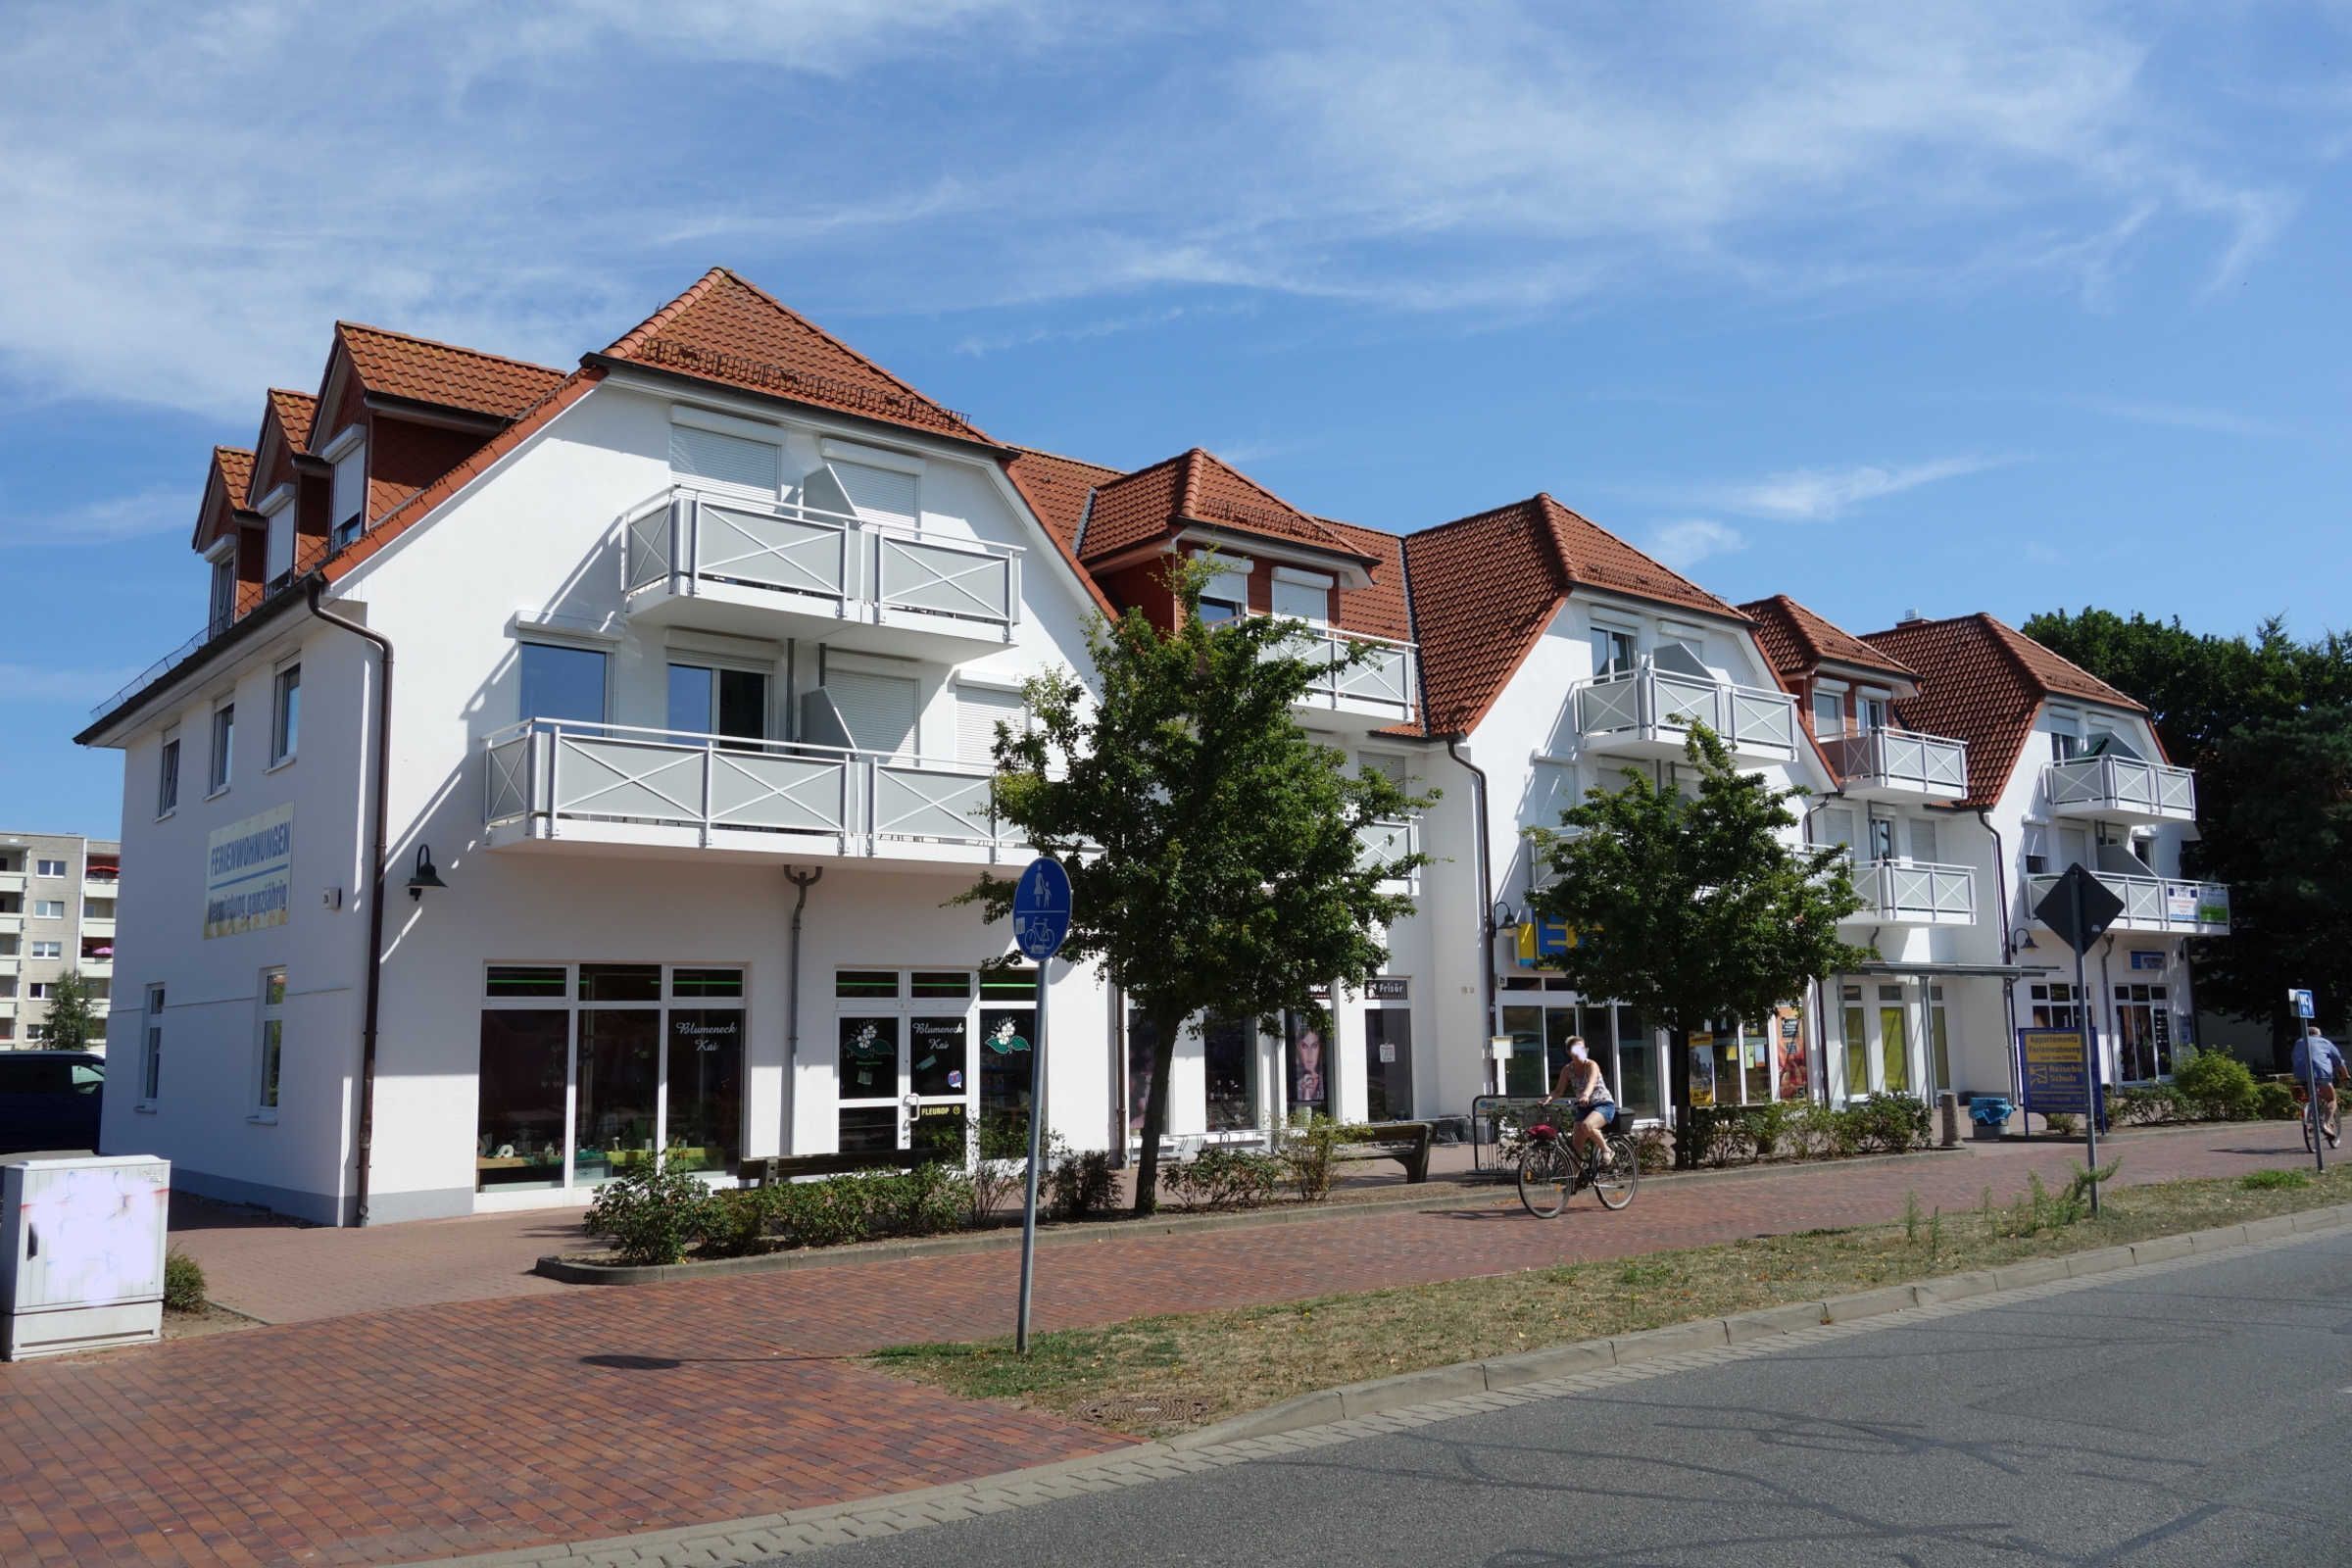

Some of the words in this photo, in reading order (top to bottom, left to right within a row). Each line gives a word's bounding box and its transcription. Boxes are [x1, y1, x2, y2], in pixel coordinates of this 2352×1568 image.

[211, 821, 291, 877] FERIENWOHNUNGEN
[1379, 983, 1404, 994] Frisör
[676, 1022, 737, 1035] Blumeneck
[912, 1022, 964, 1035] Blumeneck
[2048, 1064, 2083, 1074] Reisebü
[921, 1106, 950, 1116] FLEUROP
